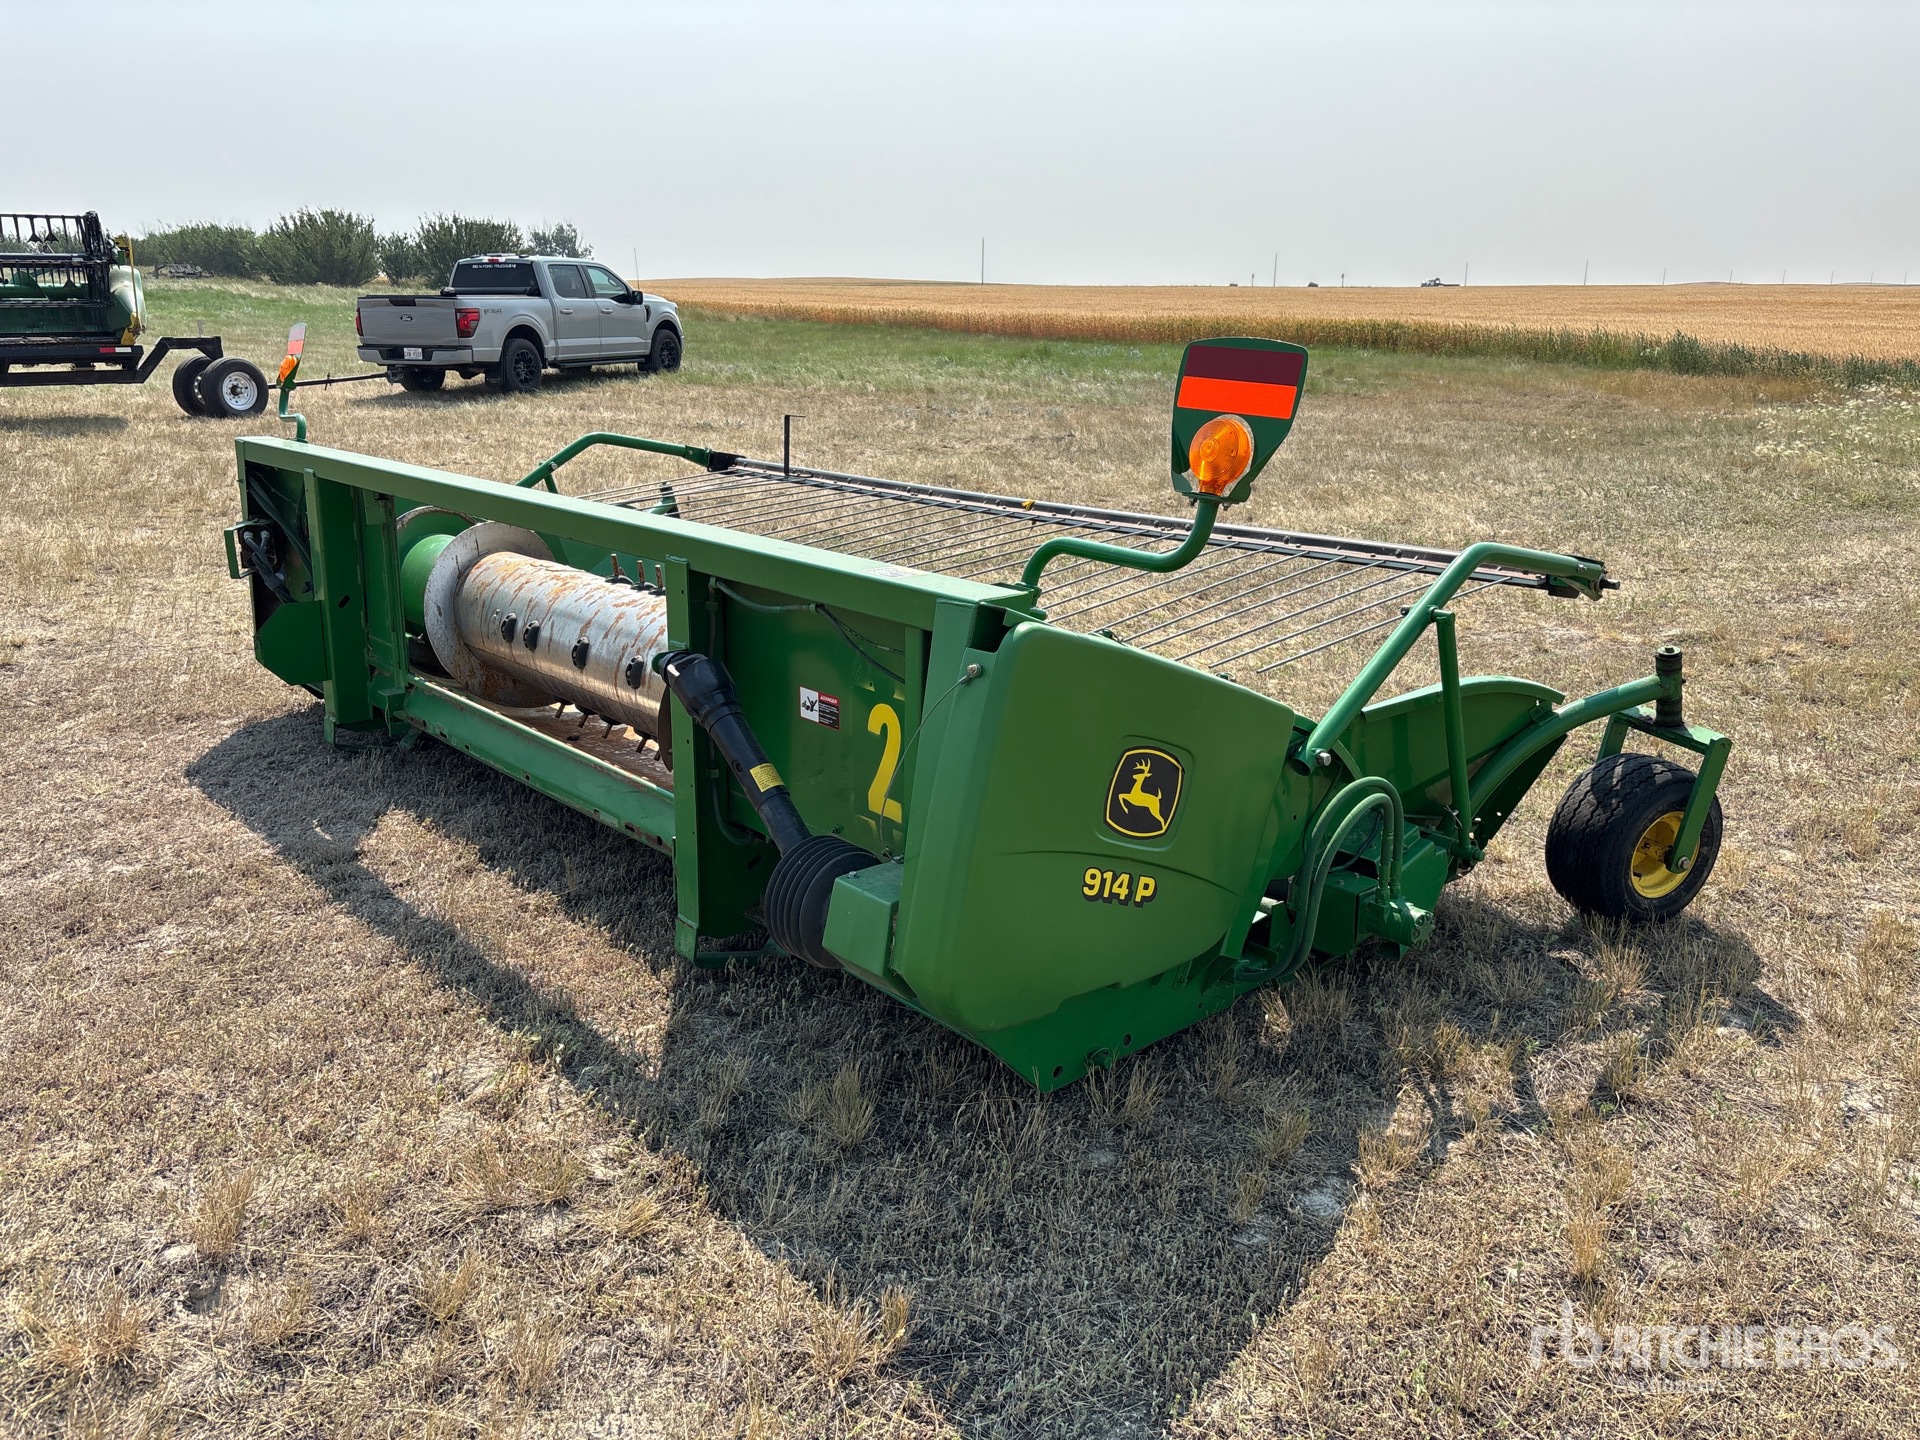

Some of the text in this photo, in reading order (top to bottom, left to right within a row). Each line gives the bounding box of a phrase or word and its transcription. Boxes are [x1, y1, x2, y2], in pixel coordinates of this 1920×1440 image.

[867, 703, 902, 824] 2
[1082, 867, 1157, 908] 914 P
